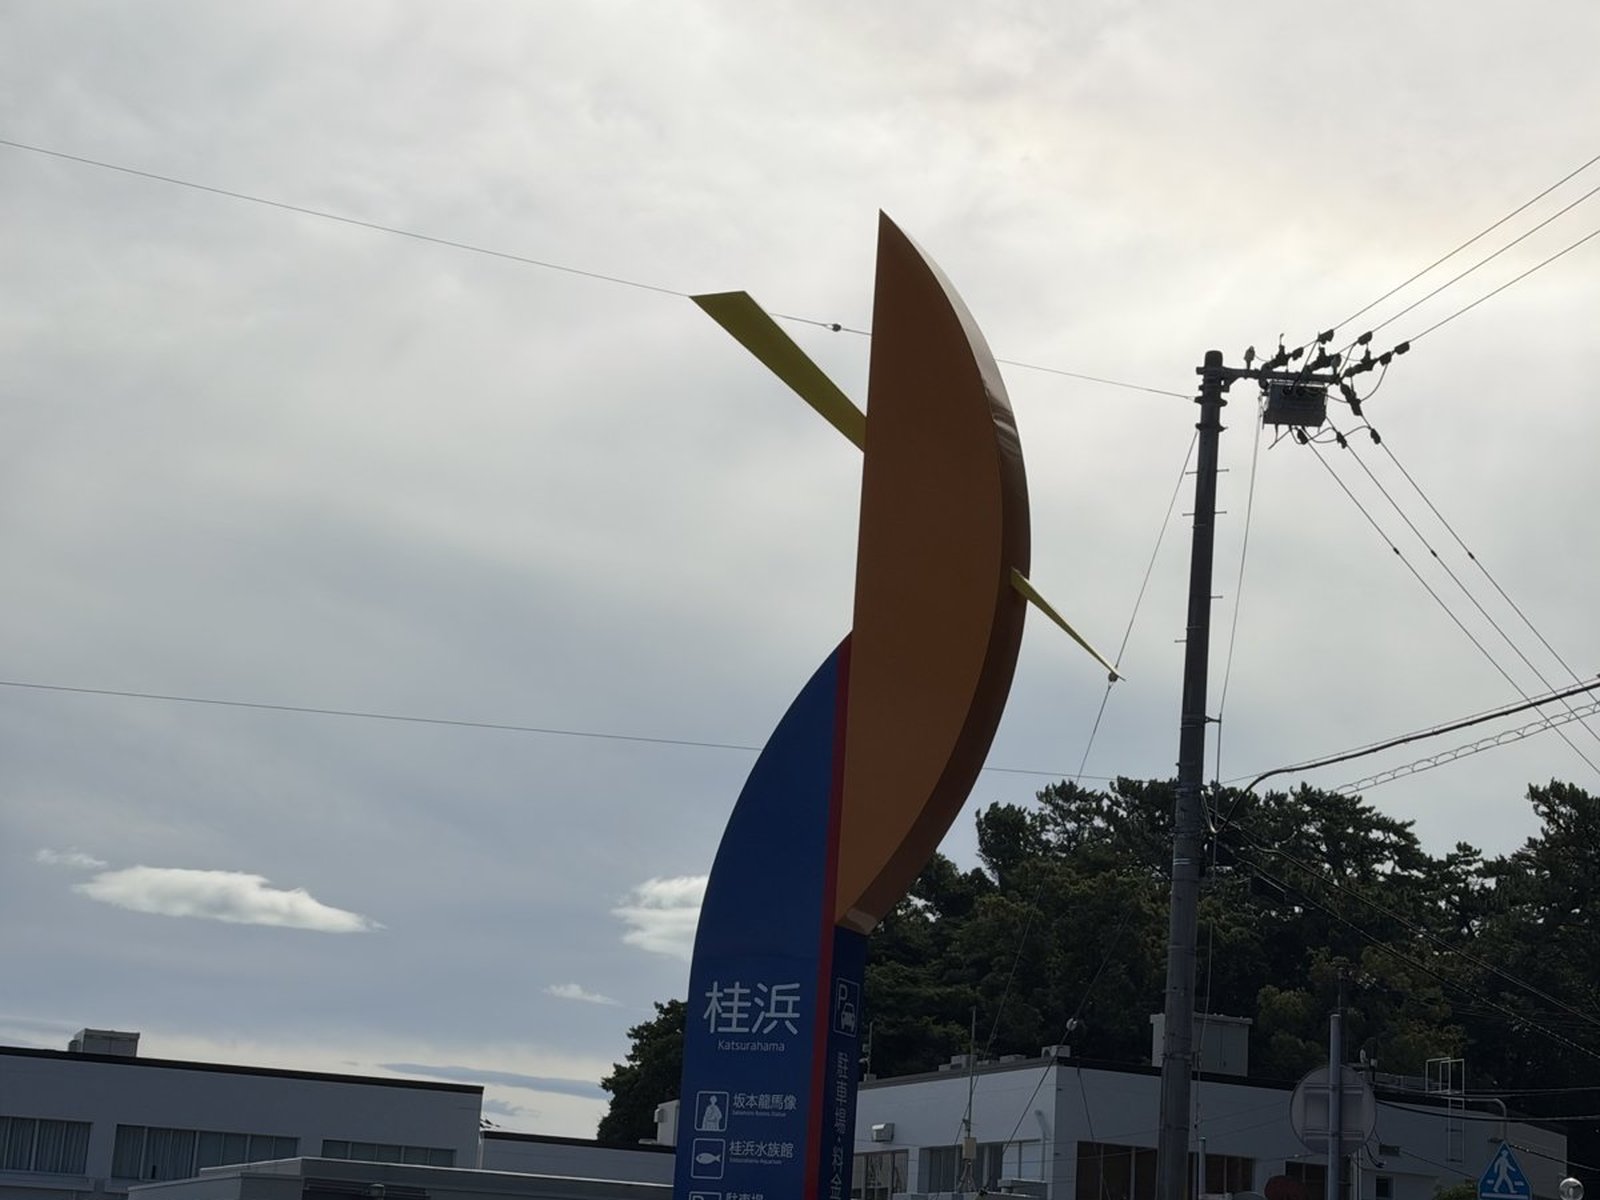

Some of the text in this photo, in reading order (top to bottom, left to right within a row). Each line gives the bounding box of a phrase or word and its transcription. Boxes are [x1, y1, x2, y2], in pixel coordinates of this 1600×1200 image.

[703, 980, 801, 1035] 桂浜
[717, 1039, 786, 1053] Katsurahama
[733, 1092, 797, 1111] 坂本龍馬像
[729, 1140, 794, 1159] 桂浜水族館
